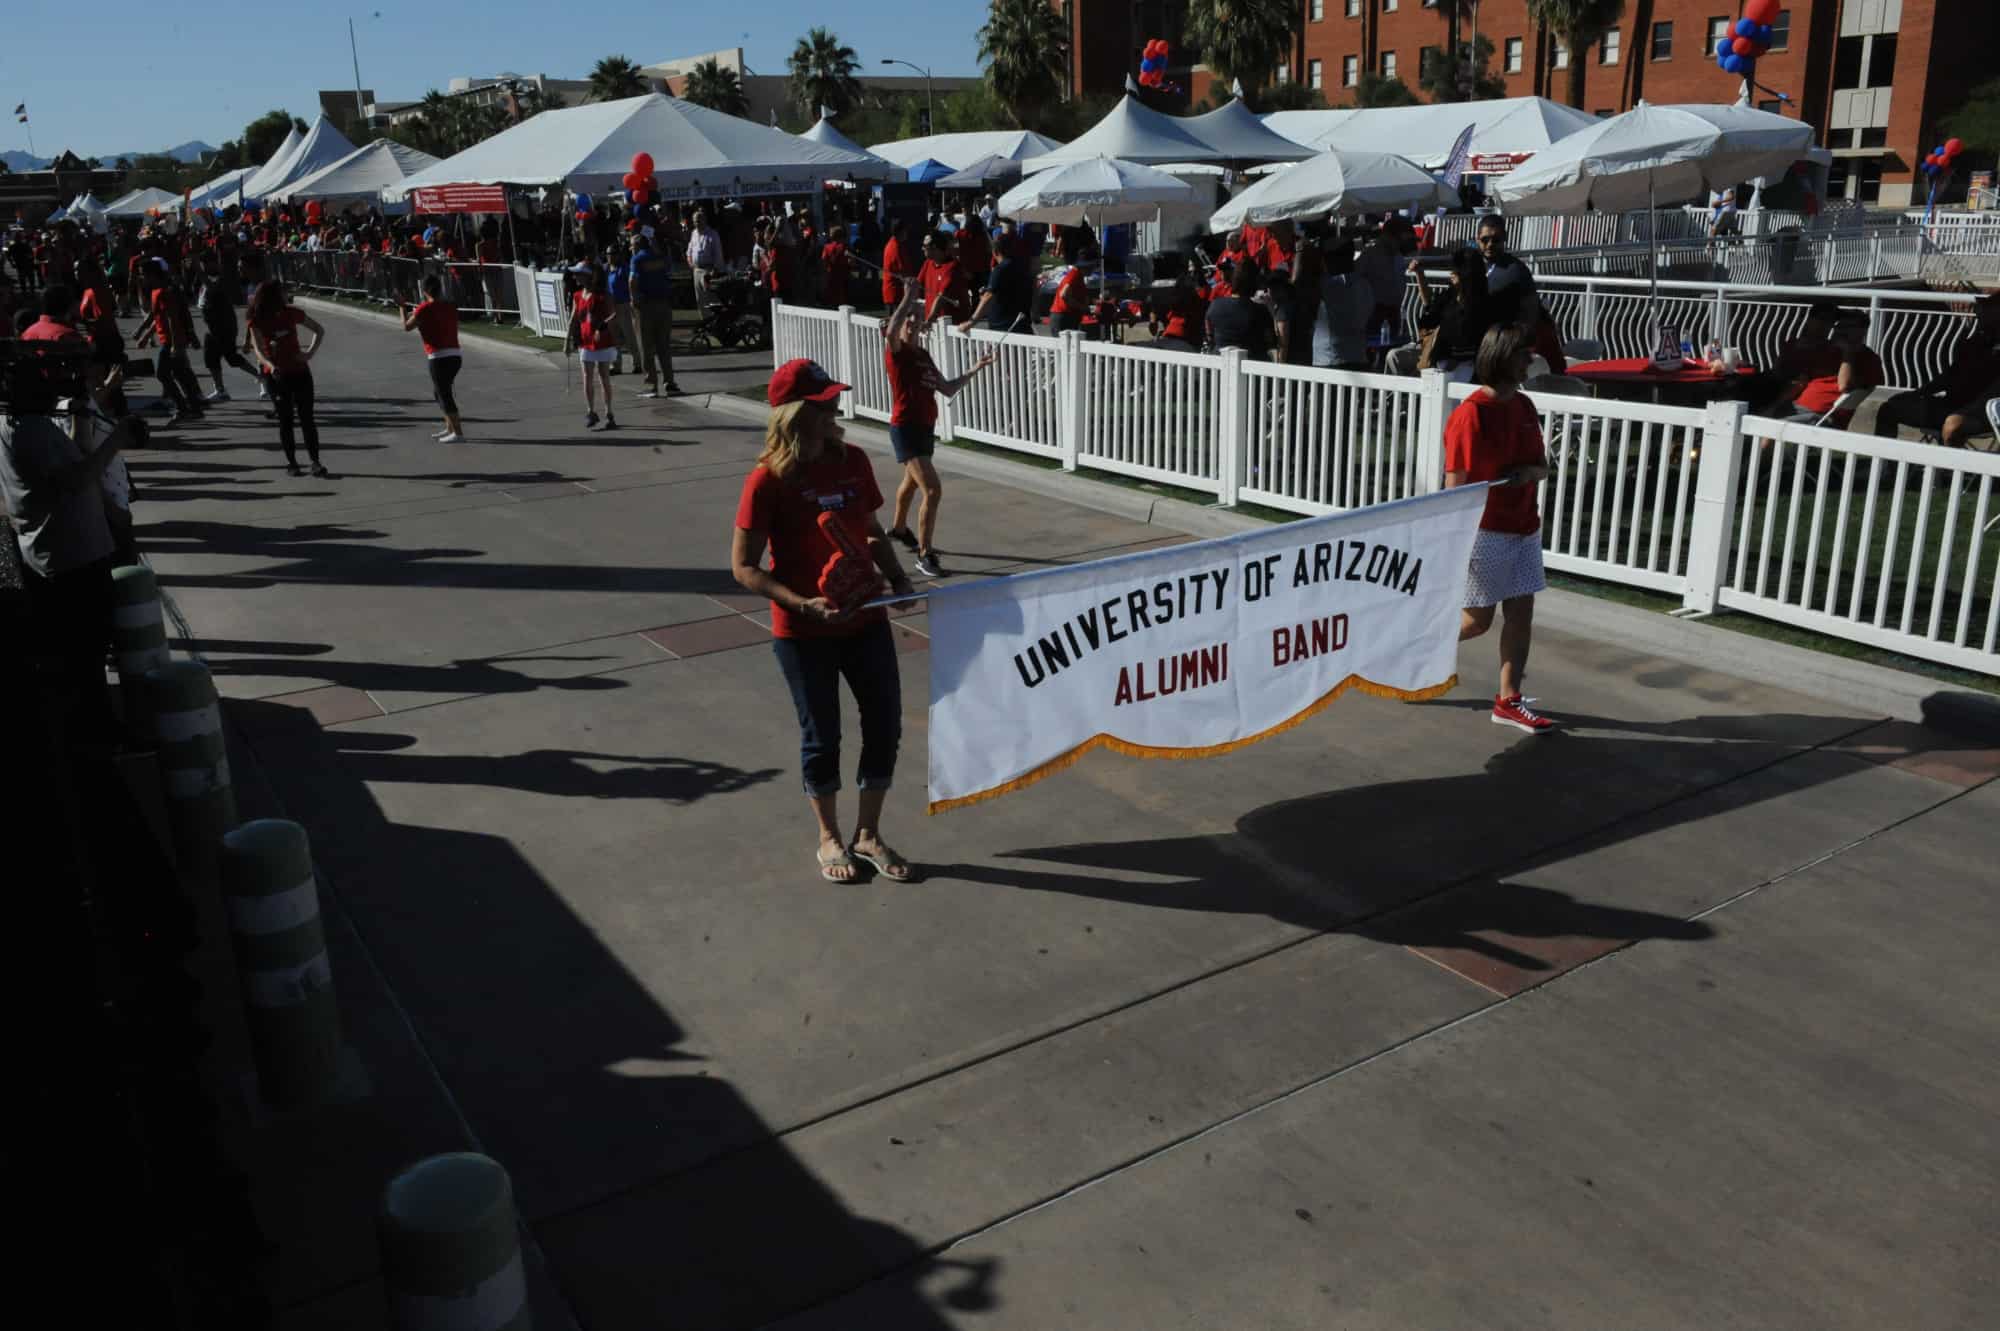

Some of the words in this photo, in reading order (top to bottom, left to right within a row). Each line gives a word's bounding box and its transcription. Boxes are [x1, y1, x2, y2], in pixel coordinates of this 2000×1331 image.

[1014, 568, 1229, 689] UNIVERSITY
[1245, 555, 1281, 601] OF
[1293, 541, 1422, 596] ARIZONA
[1114, 643, 1228, 707] ALUMNI
[1273, 614, 1348, 666] BAND
